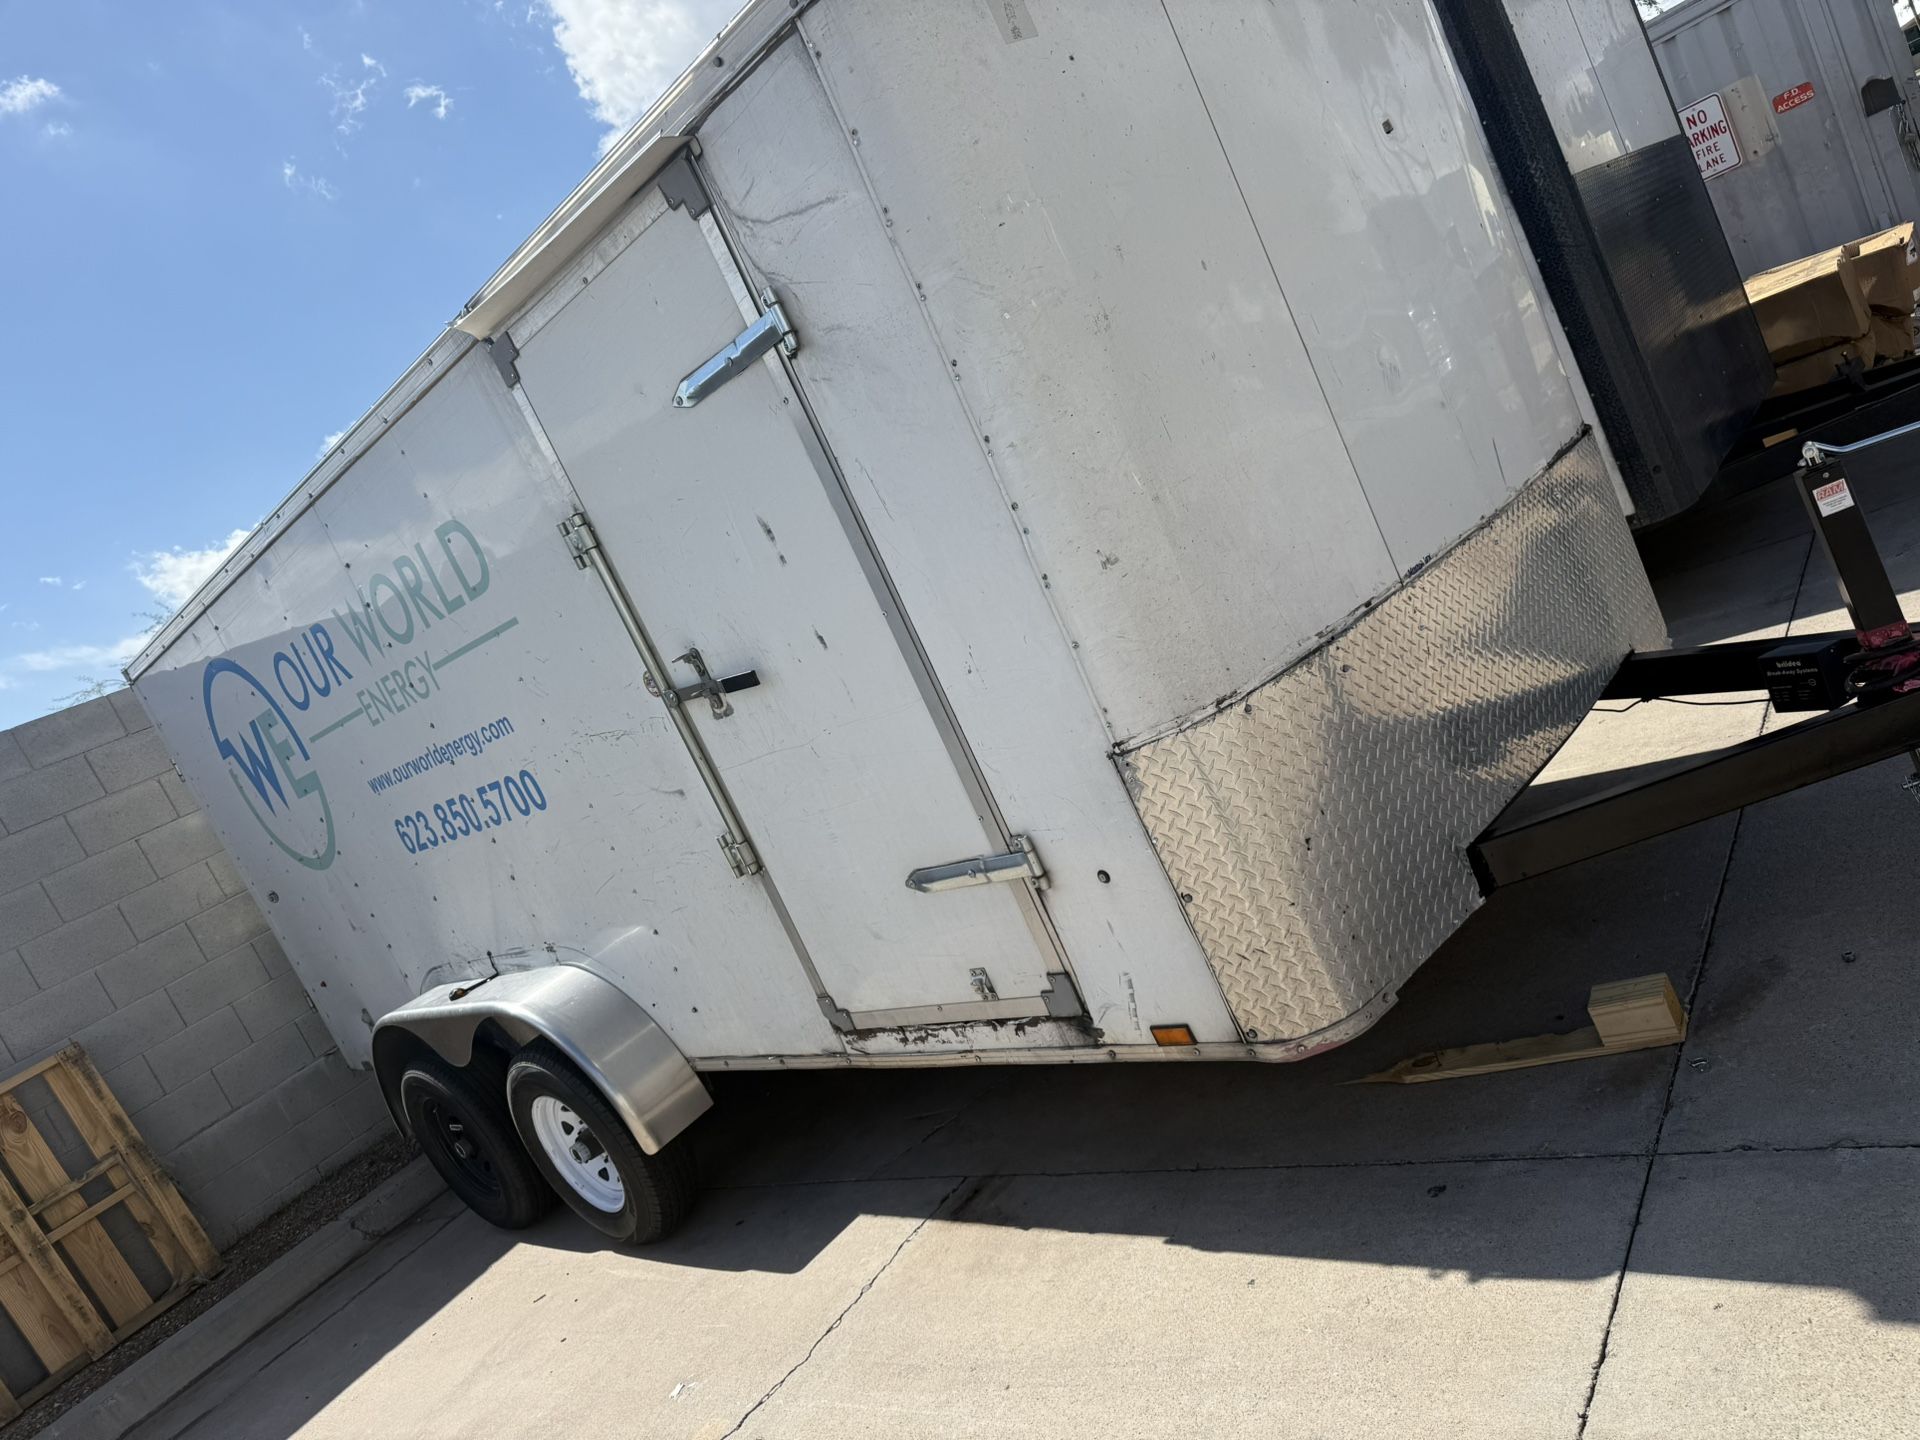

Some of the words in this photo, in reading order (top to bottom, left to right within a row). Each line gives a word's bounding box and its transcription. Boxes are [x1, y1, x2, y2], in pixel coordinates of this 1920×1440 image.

[1777, 90, 1815, 113] ACCESS
[1686, 109, 1708, 130] NO
[1689, 120, 1727, 148] ARKING
[1696, 141, 1721, 161] FIRE
[1698, 153, 1727, 173] LANE
[1817, 482, 1844, 501] RAM
[273, 623, 353, 711] OUR
[331, 519, 490, 666] WORLD
[356, 650, 440, 727] ENERGY
[367, 716, 515, 794] www.ourworldenergy.com
[394, 769, 547, 855] 623.850.5700
